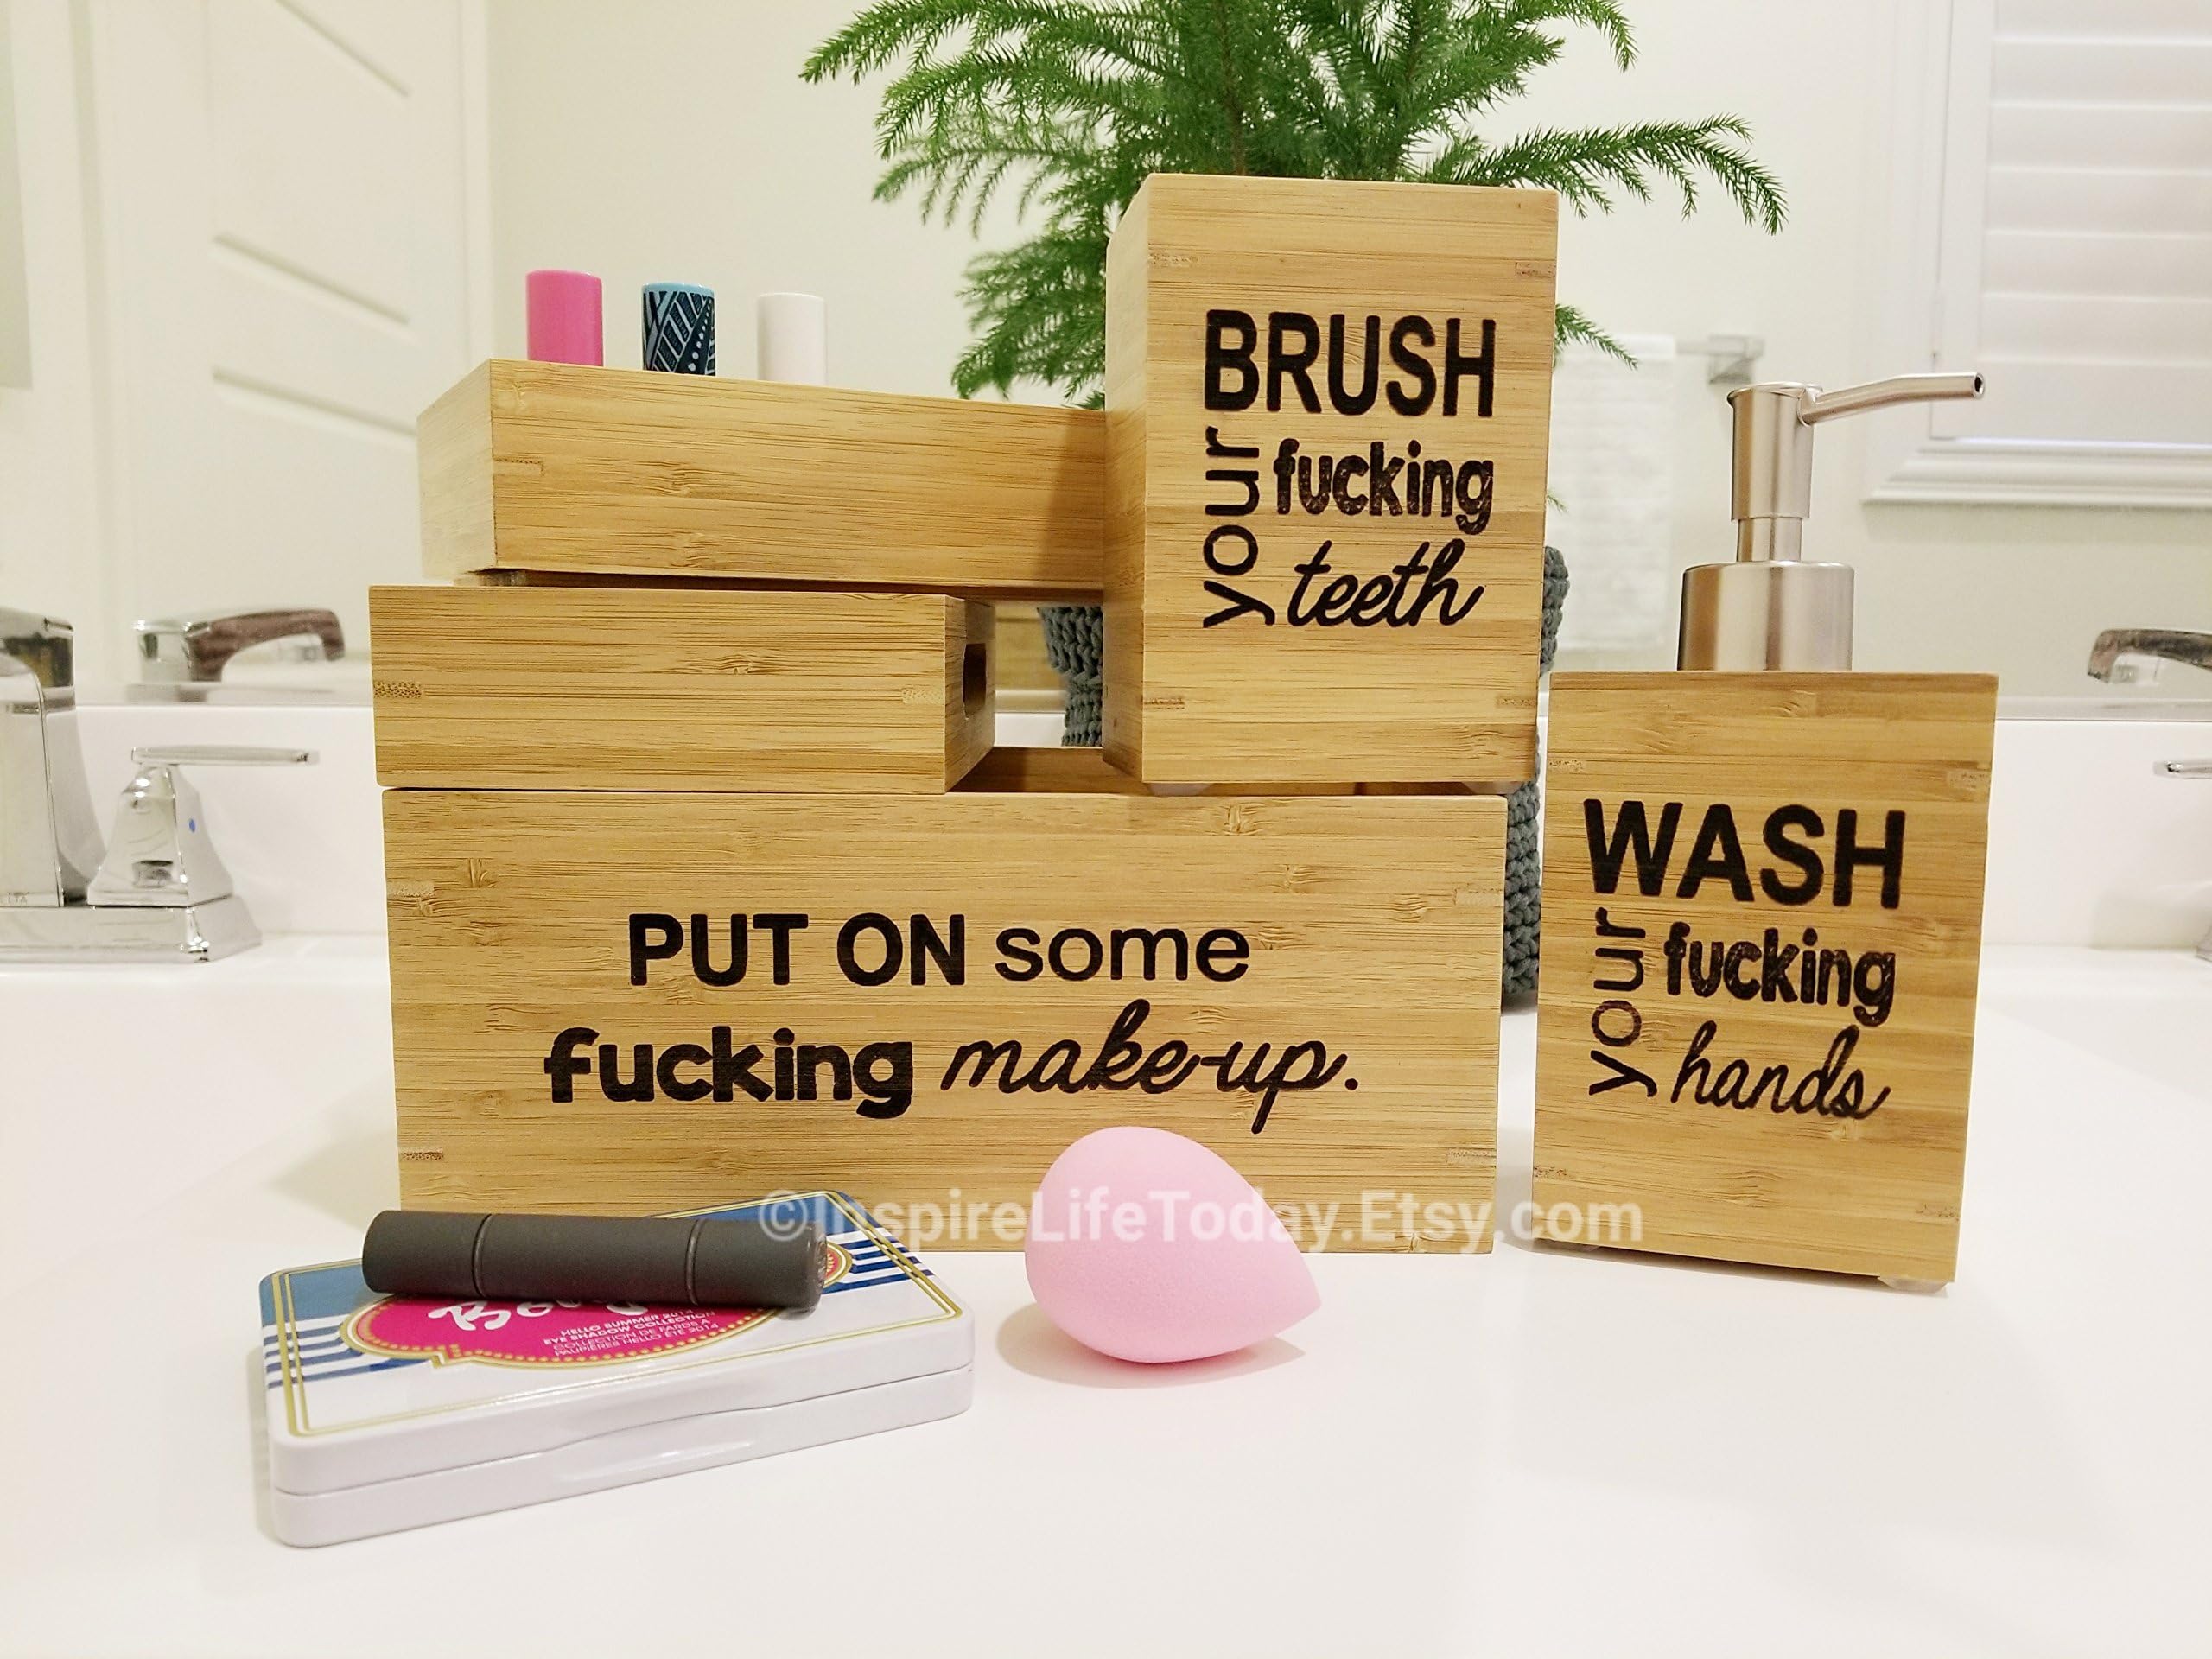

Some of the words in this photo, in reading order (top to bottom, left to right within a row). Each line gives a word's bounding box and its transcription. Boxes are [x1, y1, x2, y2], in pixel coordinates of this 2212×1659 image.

[1205, 308, 1497, 417] BRUSH
[1203, 426, 1275, 629] your
[1273, 438, 1494, 536] fucking
[1287, 538, 1484, 628] teeth
[1583, 798, 1906, 910] WASH
[628, 913, 809, 987] PUT
[836, 912, 965, 987] ON
[995, 927, 1249, 982] some
[1663, 921, 1896, 1027] fucking
[1588, 906, 1658, 1098] your
[543, 1025, 914, 1120] fucking
[940, 998, 1359, 1135] make-up.
[1670, 1020, 1891, 1119] hands
[543, 1336, 568, 1345] EYE
[569, 1325, 631, 1341] SHADOW
[633, 1311, 715, 1330] COLLECTION
[553, 1332, 636, 1351] COLLECTION
[639, 1328, 657, 1337] DE
[658, 1321, 698, 1332] FARDS
[560, 1325, 601, 1337] HELLO
[604, 1314, 660, 1329] SUMMER
[622, 1334, 661, 1345] HELLO
[688, 1323, 719, 1333] 2014
